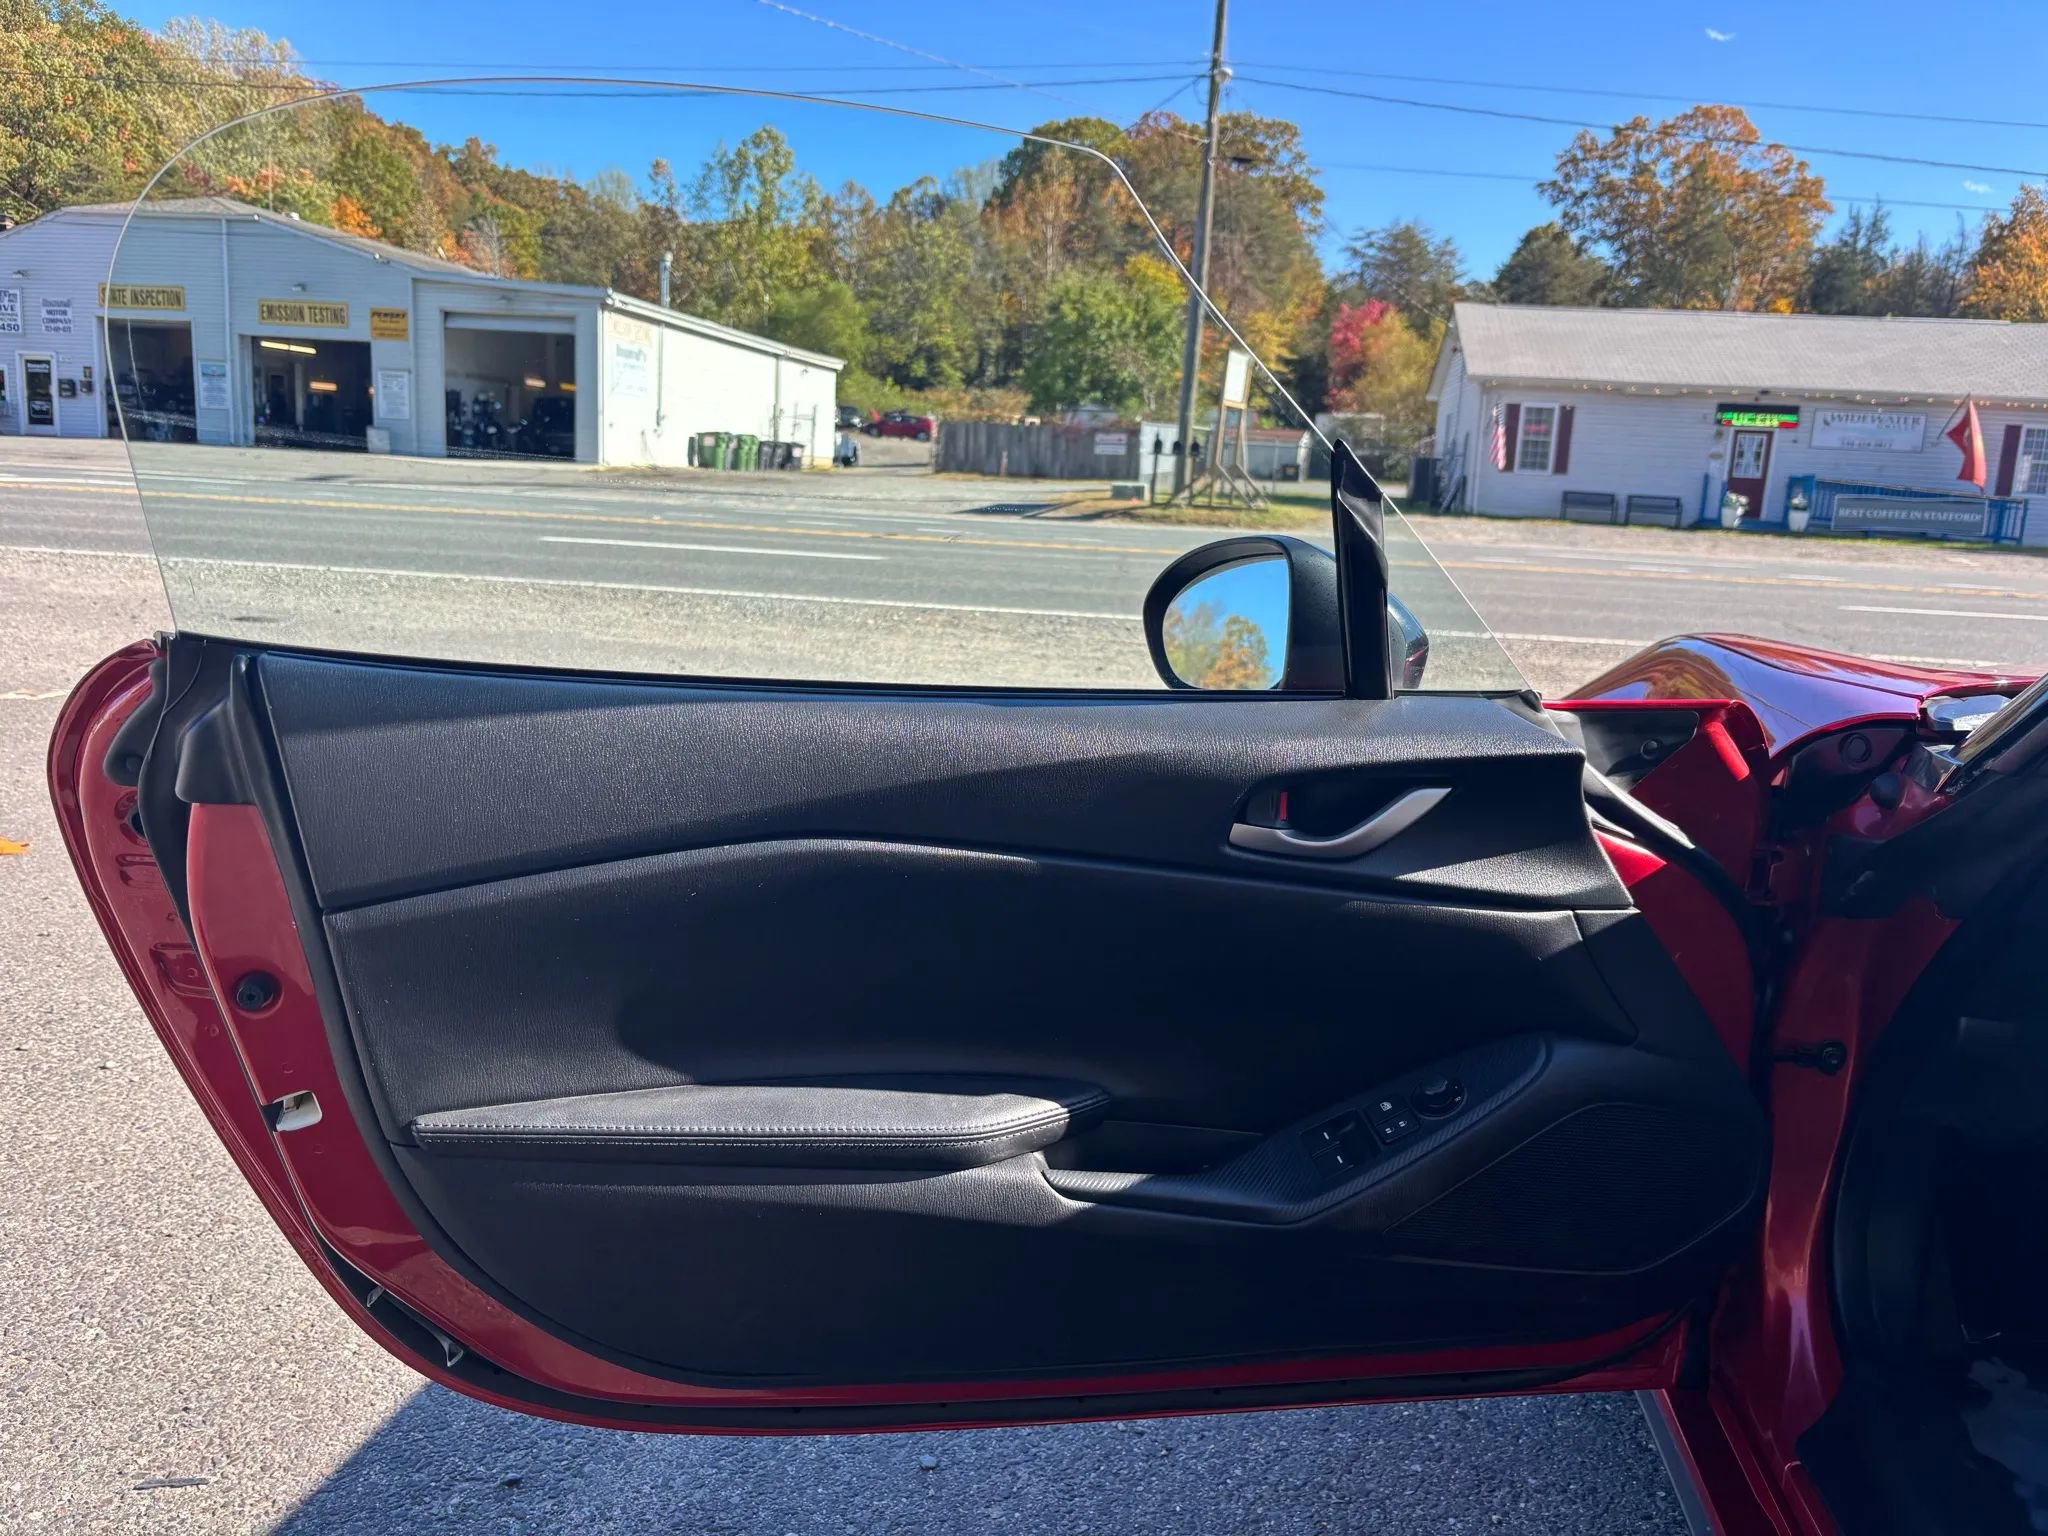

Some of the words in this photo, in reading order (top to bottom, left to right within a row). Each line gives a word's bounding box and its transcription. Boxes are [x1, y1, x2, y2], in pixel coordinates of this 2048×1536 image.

[100, 287, 127, 305] SATE
[130, 288, 182, 307] INSPECTION
[42, 317, 72, 325] COMPANY
[261, 303, 305, 322] EMISSION
[308, 305, 346, 325] TESTING
[1831, 411, 1921, 426] WIDEWATER
[1837, 507, 1865, 518] BEST
[1866, 508, 1908, 520] COFFEE
[1909, 509, 1923, 520] IN
